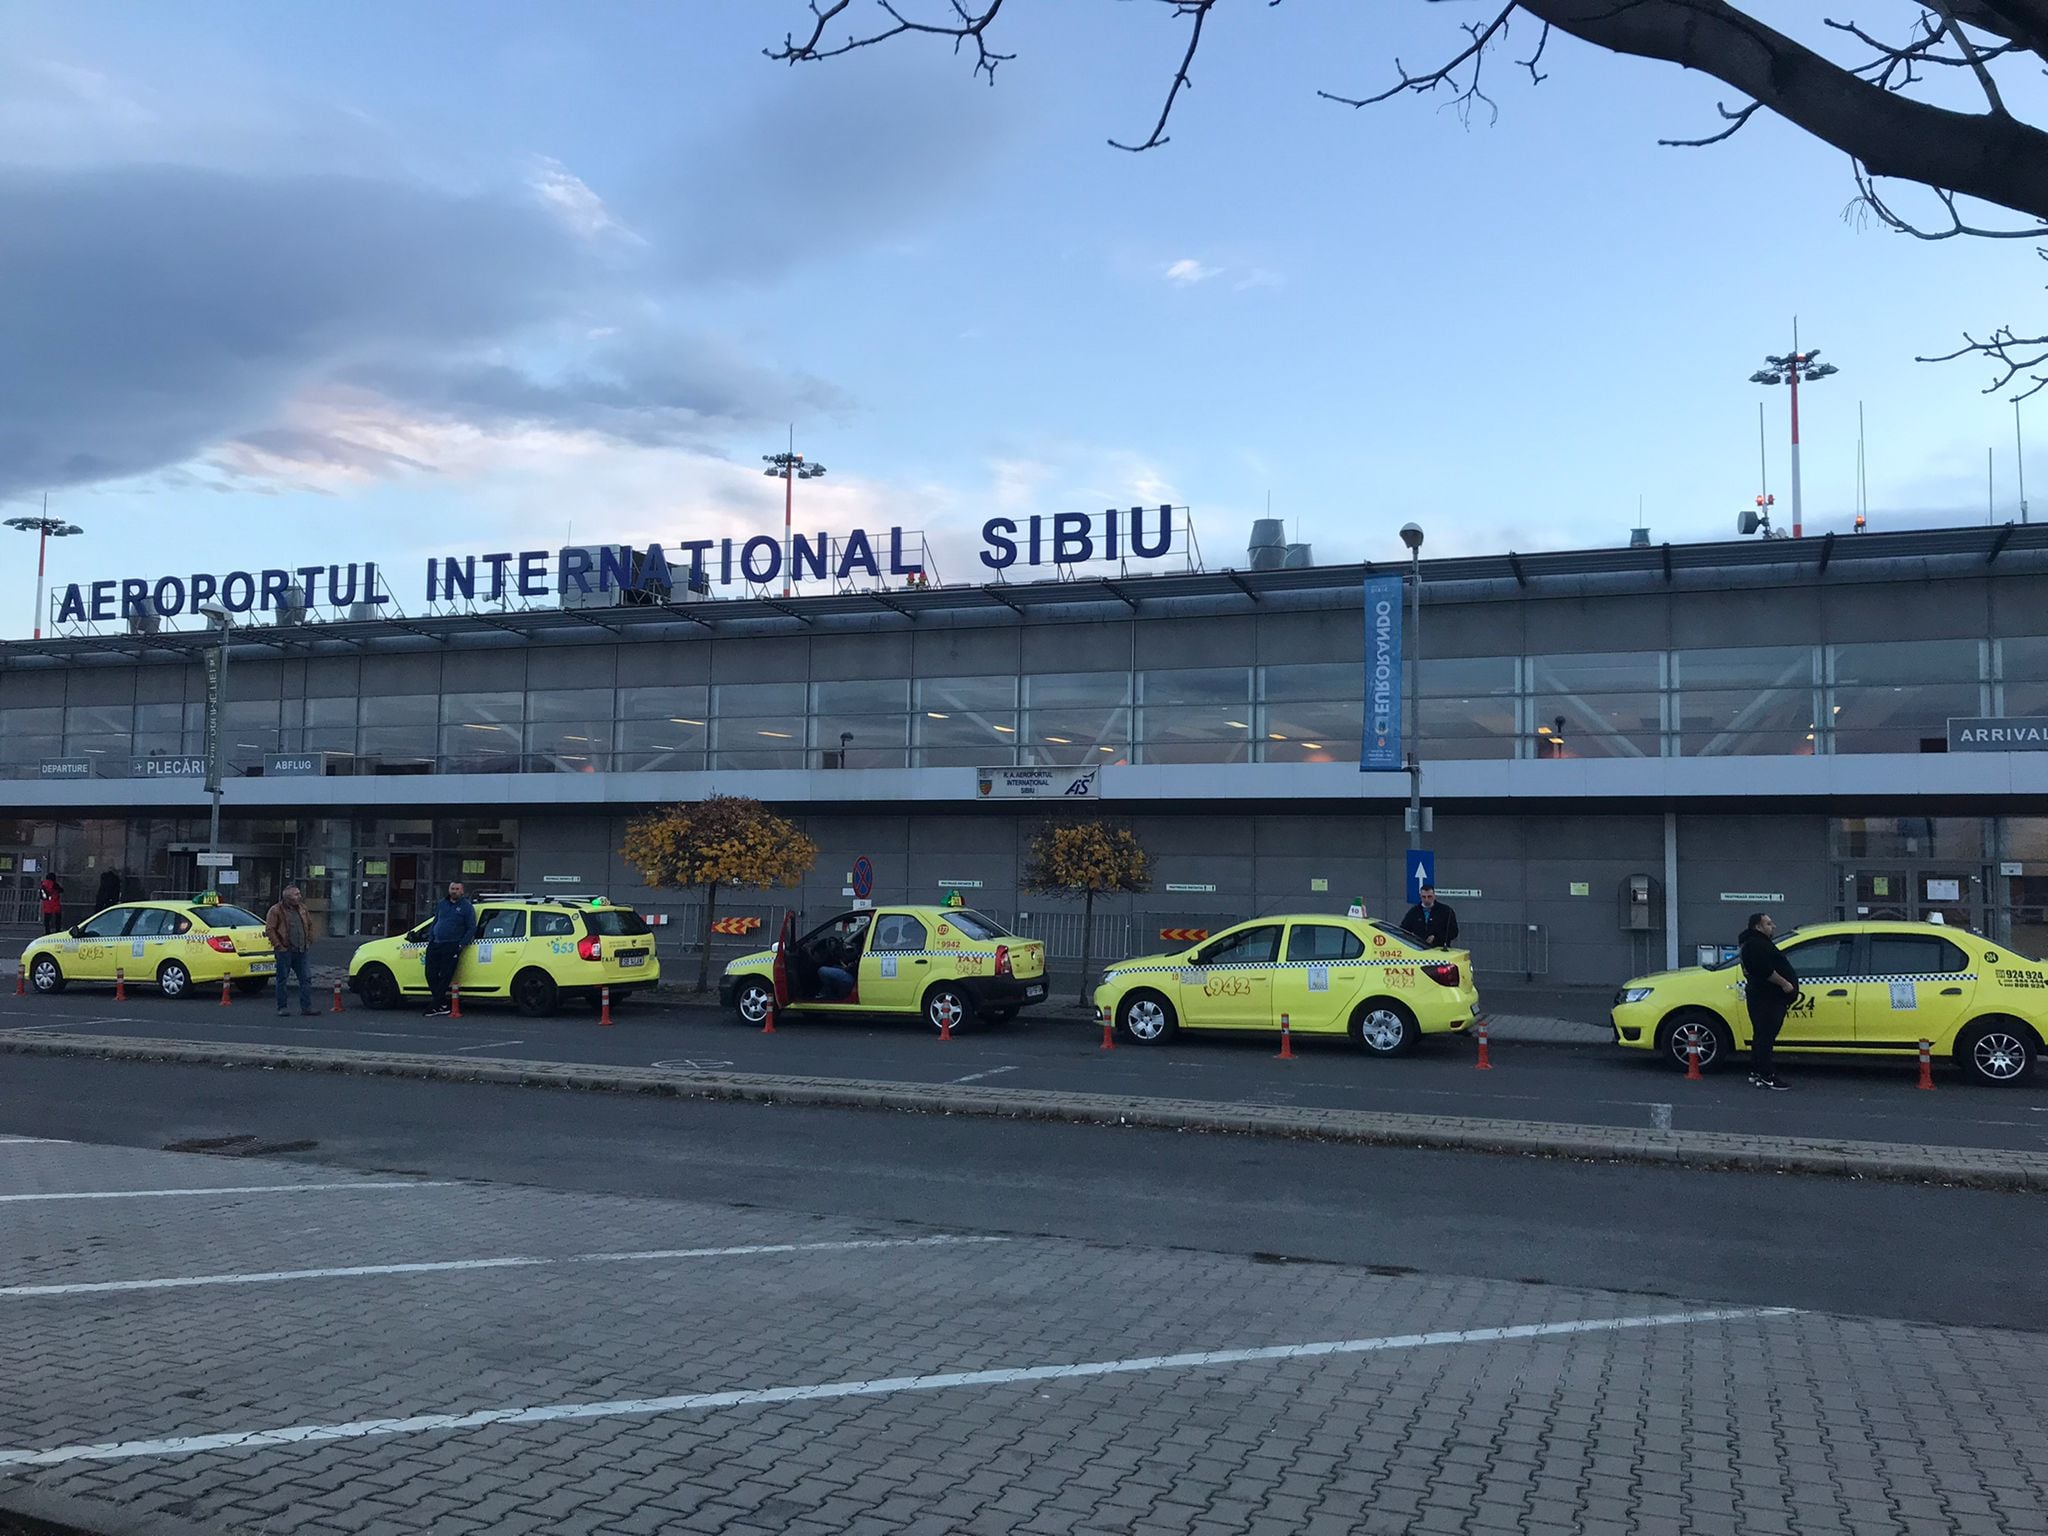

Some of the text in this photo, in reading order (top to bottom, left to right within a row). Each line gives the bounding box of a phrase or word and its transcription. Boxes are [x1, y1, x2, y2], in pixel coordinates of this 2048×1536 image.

[57, 504, 1171, 623] AEROPORTUL INTERNATIONAL SIBIU
[42, 763, 89, 774] DEPARTURE
[147, 758, 205, 774] PLECĂRI
[275, 760, 312, 770] ABFLUG
[1375, 936, 1384, 945] 10
[552, 942, 575, 954] 953
[958, 956, 983, 964] TAXI
[1384, 968, 1415, 976] TAXI
[2006, 970, 2023, 979] 924
[2025, 970, 2044, 979] 924
[1209, 976, 1250, 996] 942
[1383, 976, 1415, 989] 942
[1785, 991, 1815, 1010] 24
